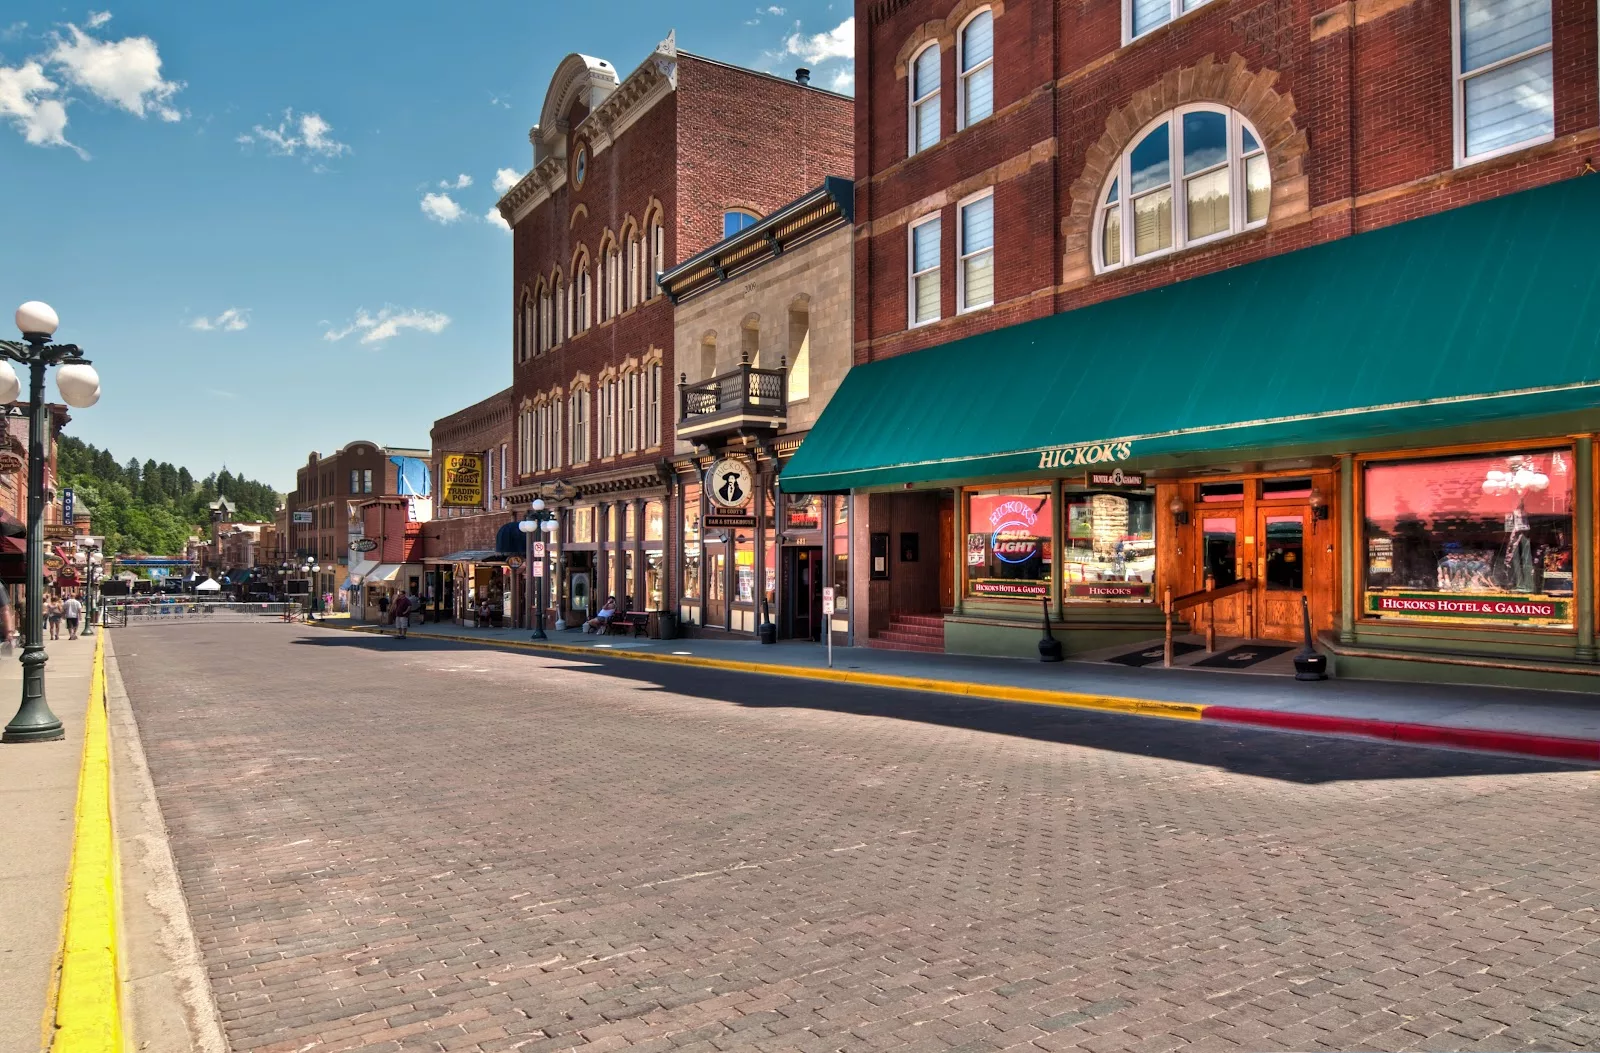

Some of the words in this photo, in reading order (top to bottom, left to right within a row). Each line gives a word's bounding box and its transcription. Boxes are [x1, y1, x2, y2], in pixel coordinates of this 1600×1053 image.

[1038, 441, 1132, 468] HICKOK'S
[451, 458, 476, 468] GOLD
[446, 469, 480, 484] NUGGET
[716, 462, 749, 482] HICKOK'S
[1093, 475, 1108, 483] HOTEL
[1122, 476, 1142, 484] GAMING
[993, 542, 1036, 553] LIGHT
[975, 583, 998, 591] HICKOK'S
[1023, 586, 1046, 594] GAMING
[1382, 598, 1435, 610] HICKOK'S
[1437, 601, 1479, 612] HOTEL
[1481, 604, 1492, 612] &
[1495, 602, 1551, 615] GAMING
